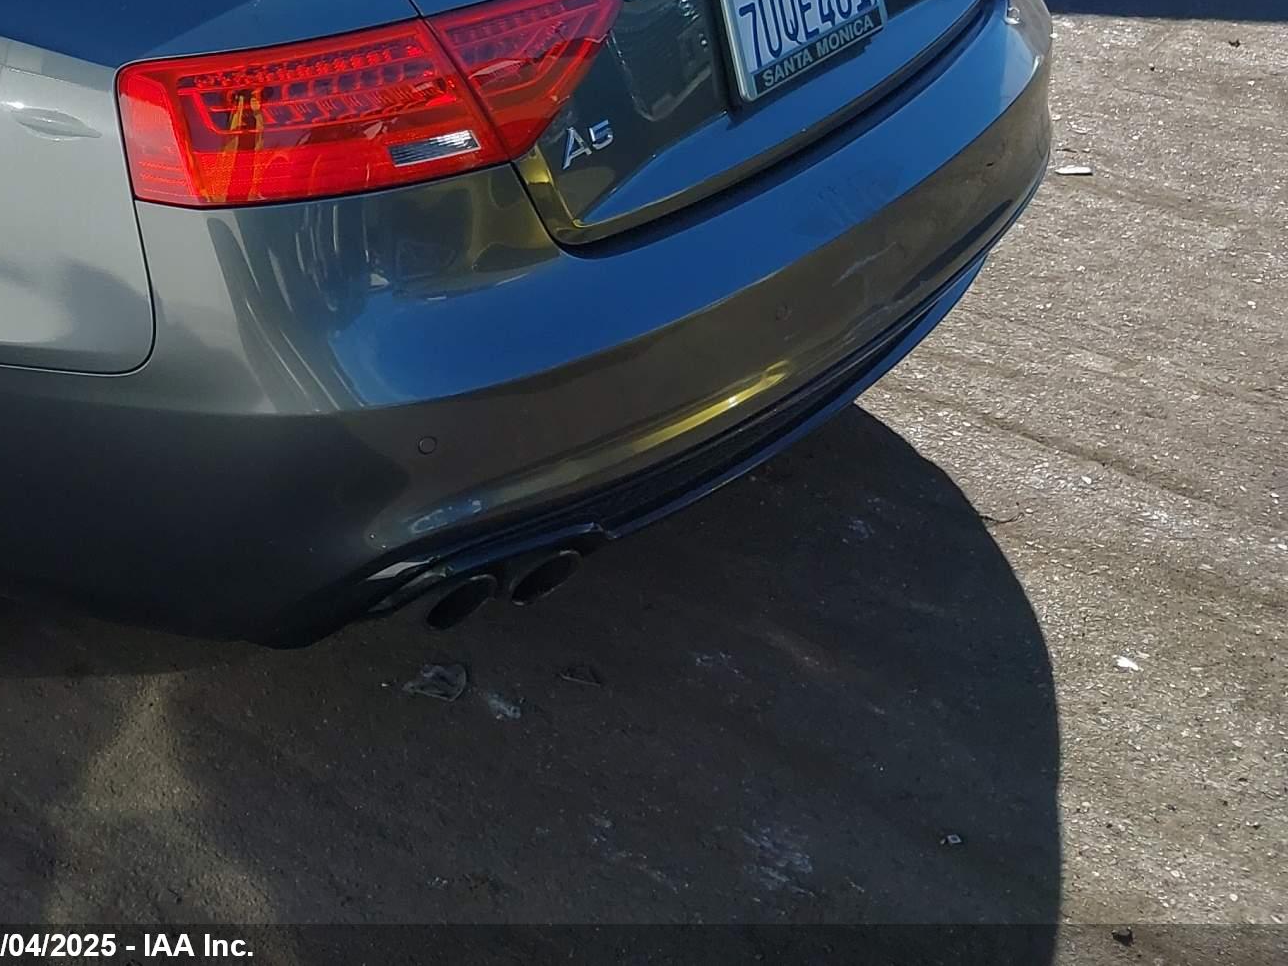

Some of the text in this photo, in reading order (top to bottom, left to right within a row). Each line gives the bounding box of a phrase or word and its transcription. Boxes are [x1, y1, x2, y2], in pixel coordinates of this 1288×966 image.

[762, 14, 875, 88] SANTA MONICA
[562, 119, 614, 170] A5
